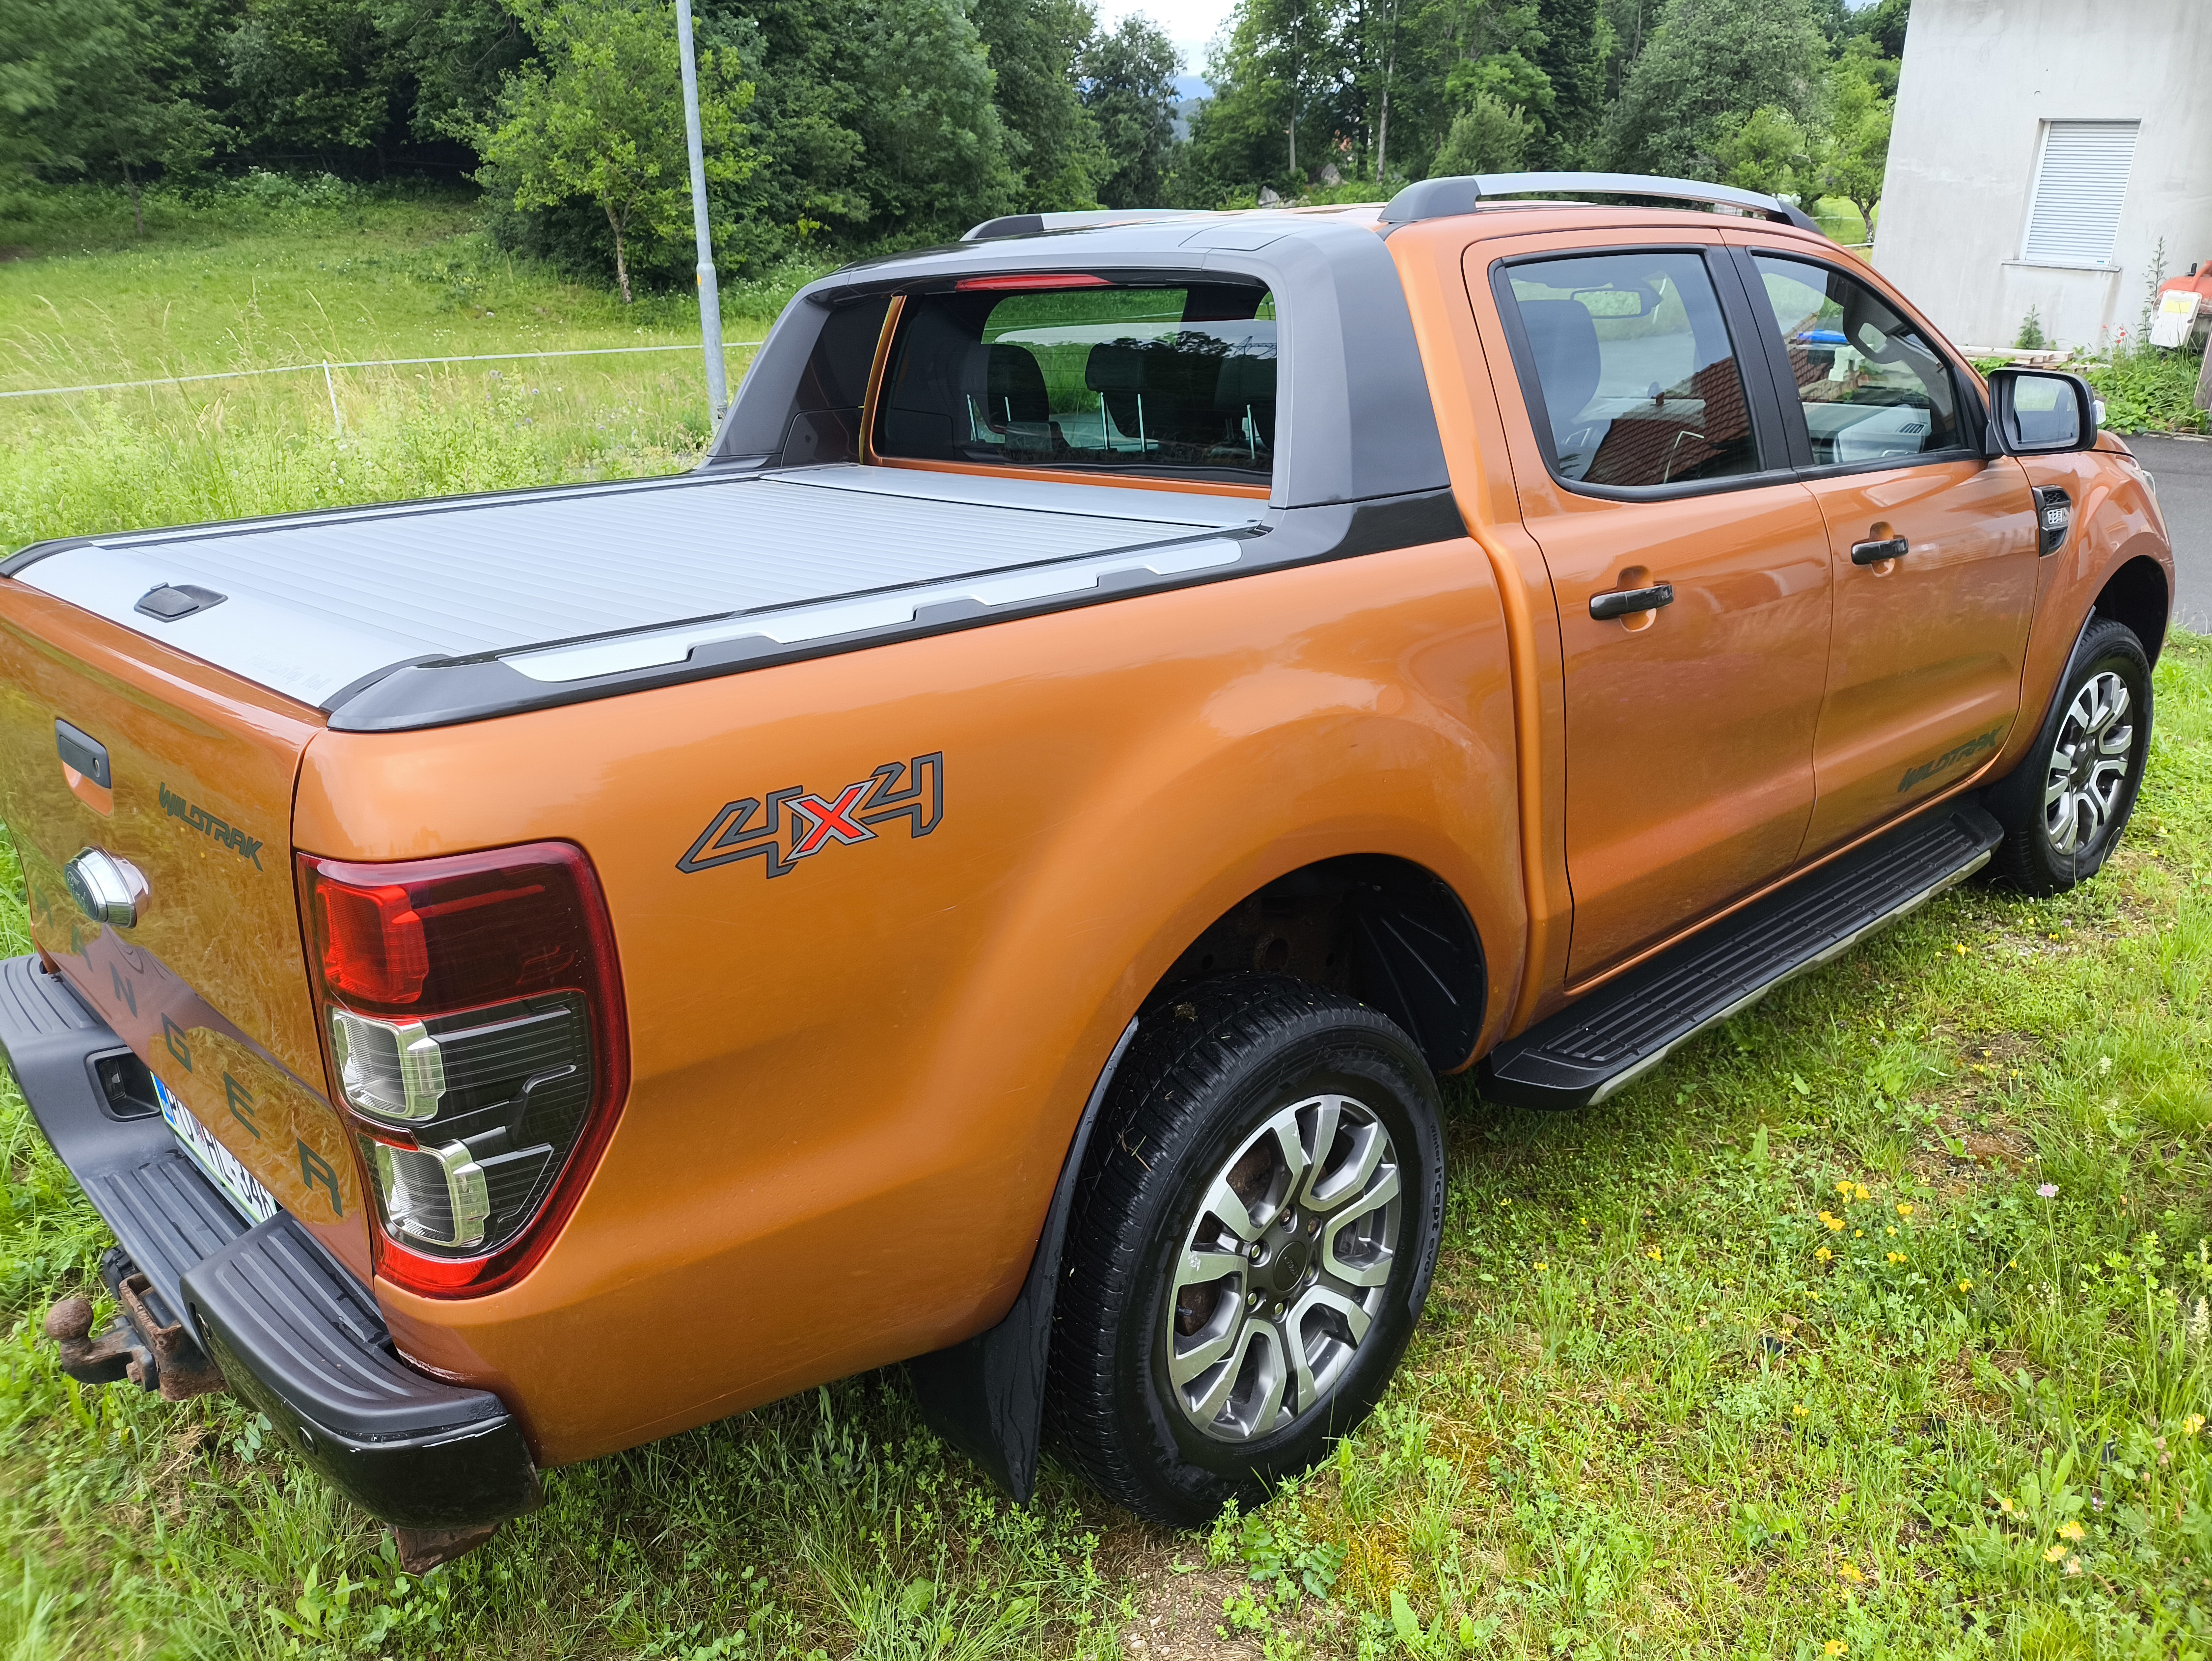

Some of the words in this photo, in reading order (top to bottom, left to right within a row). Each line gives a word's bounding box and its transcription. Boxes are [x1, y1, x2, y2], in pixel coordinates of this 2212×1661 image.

[159, 782, 263, 872] WILDTRAK
[33, 883, 343, 1218] RANGER
[1430, 1122, 1441, 1163] Winter
